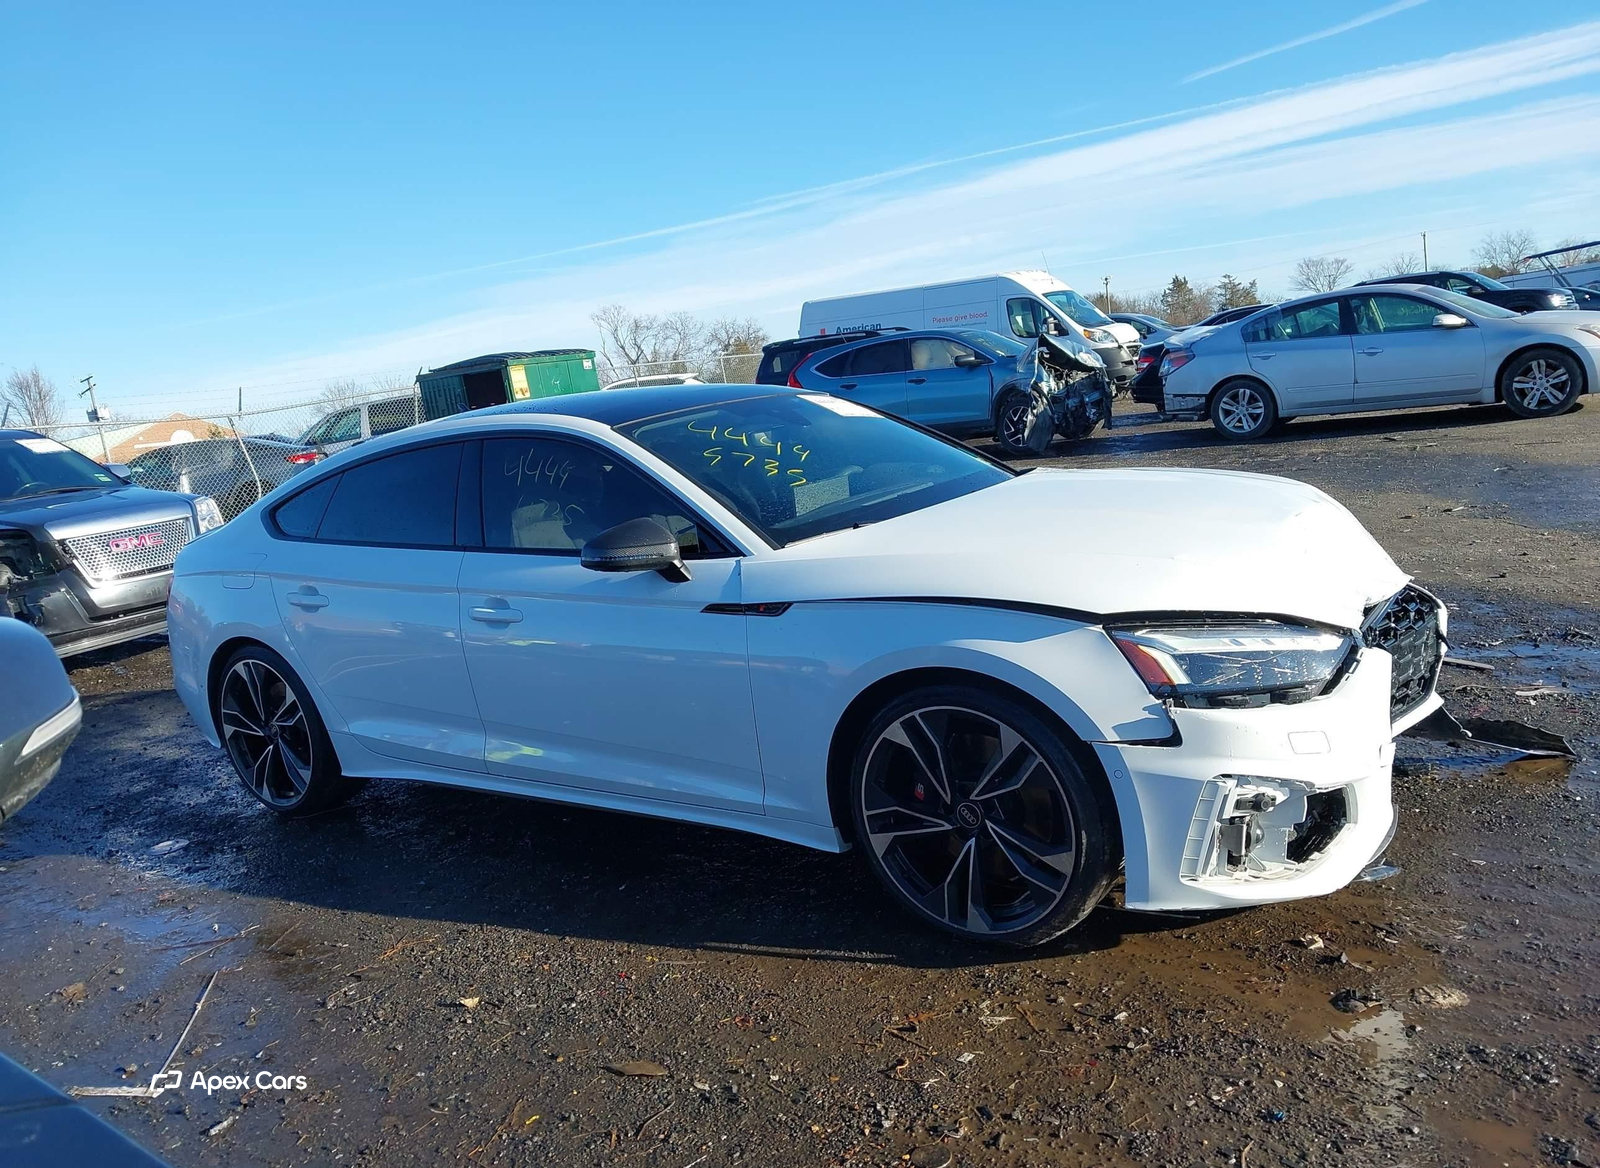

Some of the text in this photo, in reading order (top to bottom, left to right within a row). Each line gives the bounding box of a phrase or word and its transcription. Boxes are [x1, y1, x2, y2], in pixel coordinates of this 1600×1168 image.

[954, 314, 968, 322] give
[836, 322, 882, 334] American
[109, 532, 165, 552] GMC
